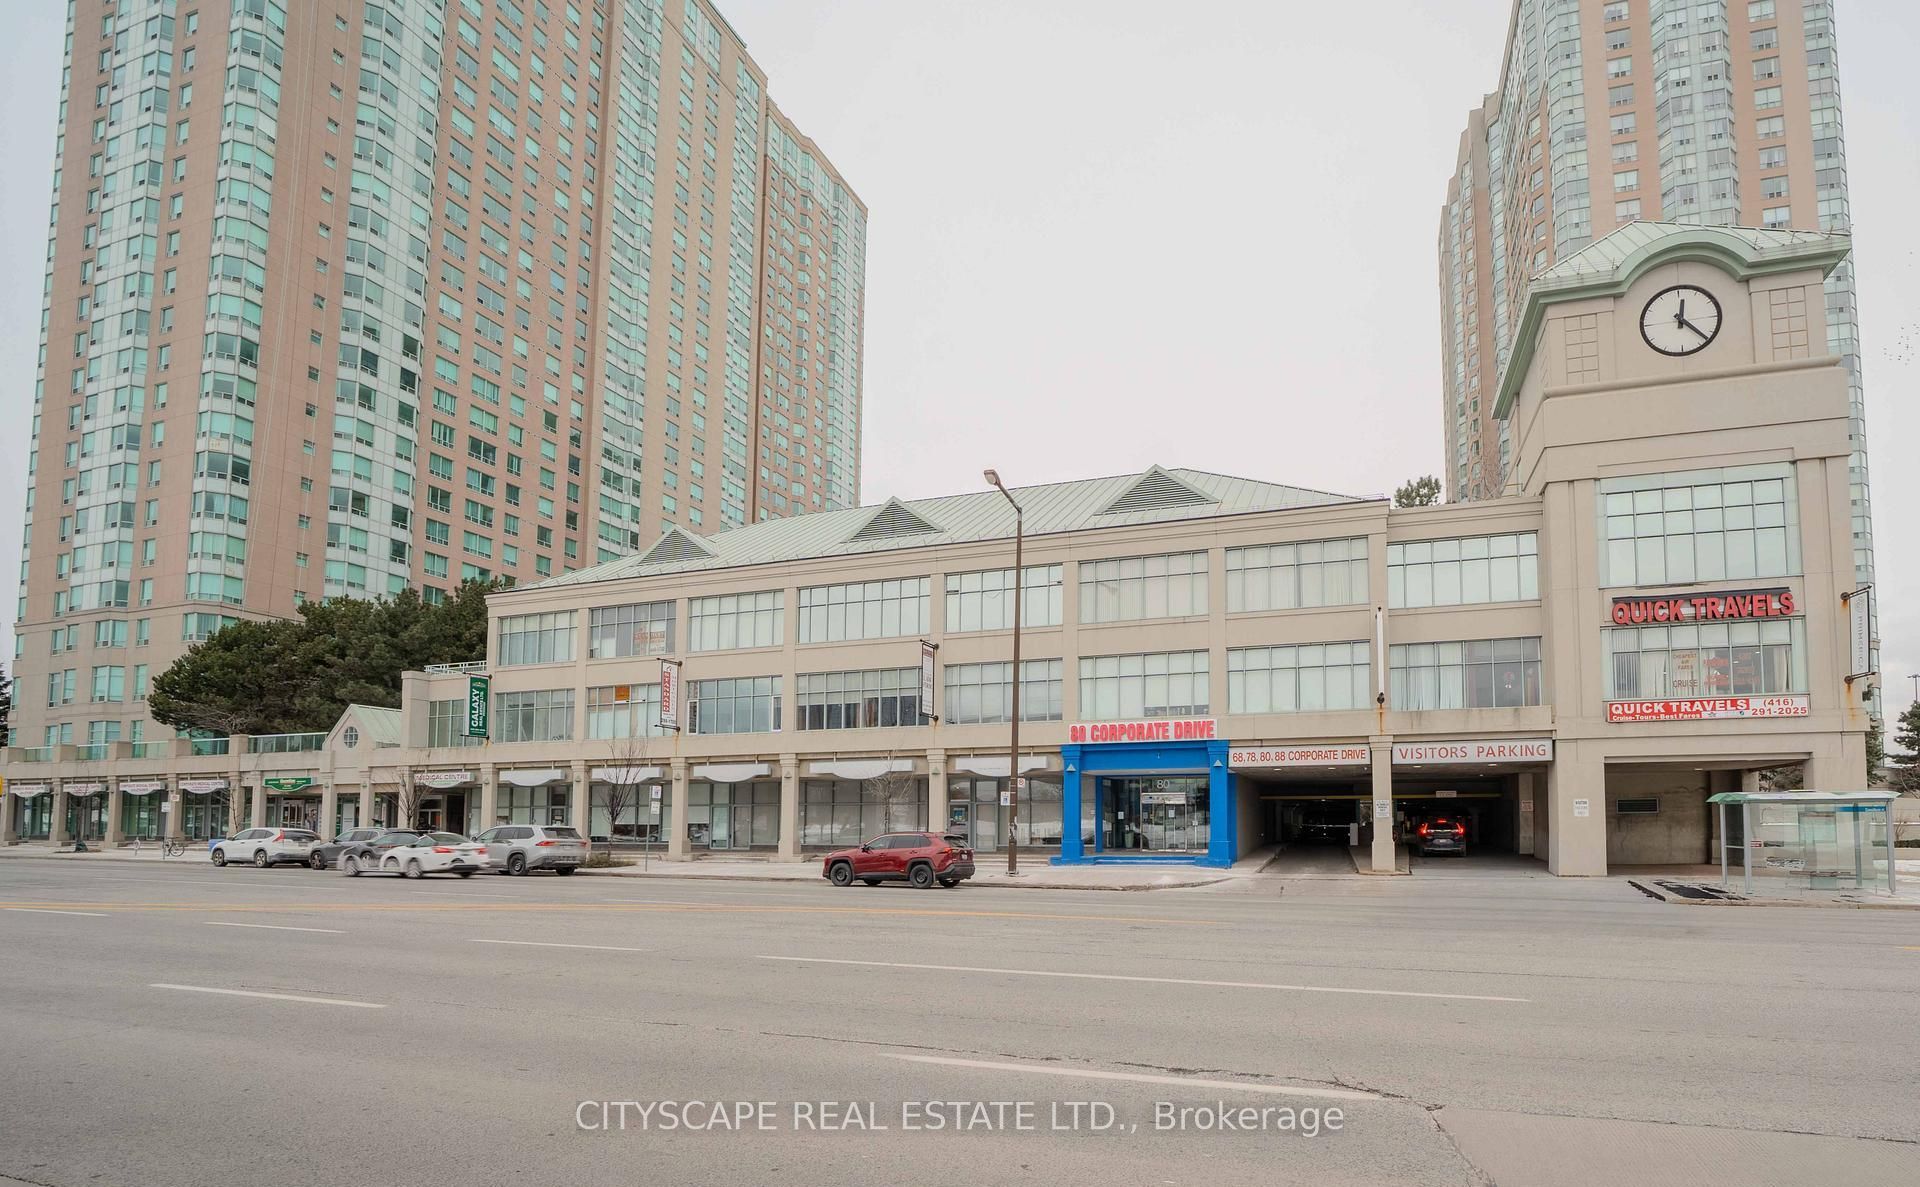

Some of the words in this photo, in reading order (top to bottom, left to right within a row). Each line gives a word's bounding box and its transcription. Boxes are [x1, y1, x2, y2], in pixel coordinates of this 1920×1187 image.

[1612, 599, 1686, 626] QUICK
[1691, 592, 1795, 620] TRAVELS
[1672, 679, 1699, 688] CRUISE
[1611, 702, 1665, 715] QUICK
[1669, 700, 1748, 712] TRAVELS
[1763, 698, 1794, 708] (416)
[1752, 706, 1807, 716] 291-2025
[1070, 725, 1086, 742] 80
[1090, 722, 1170, 742] CORPORATE
[1174, 720, 1215, 739] DRIVE
[1288, 750, 1338, 761] CORPORATE
[1341, 749, 1366, 760] DRIVE
[1399, 746, 1468, 760] VISITORS
[1476, 744, 1547, 758] PARKING
[1156, 779, 1170, 789] 80
